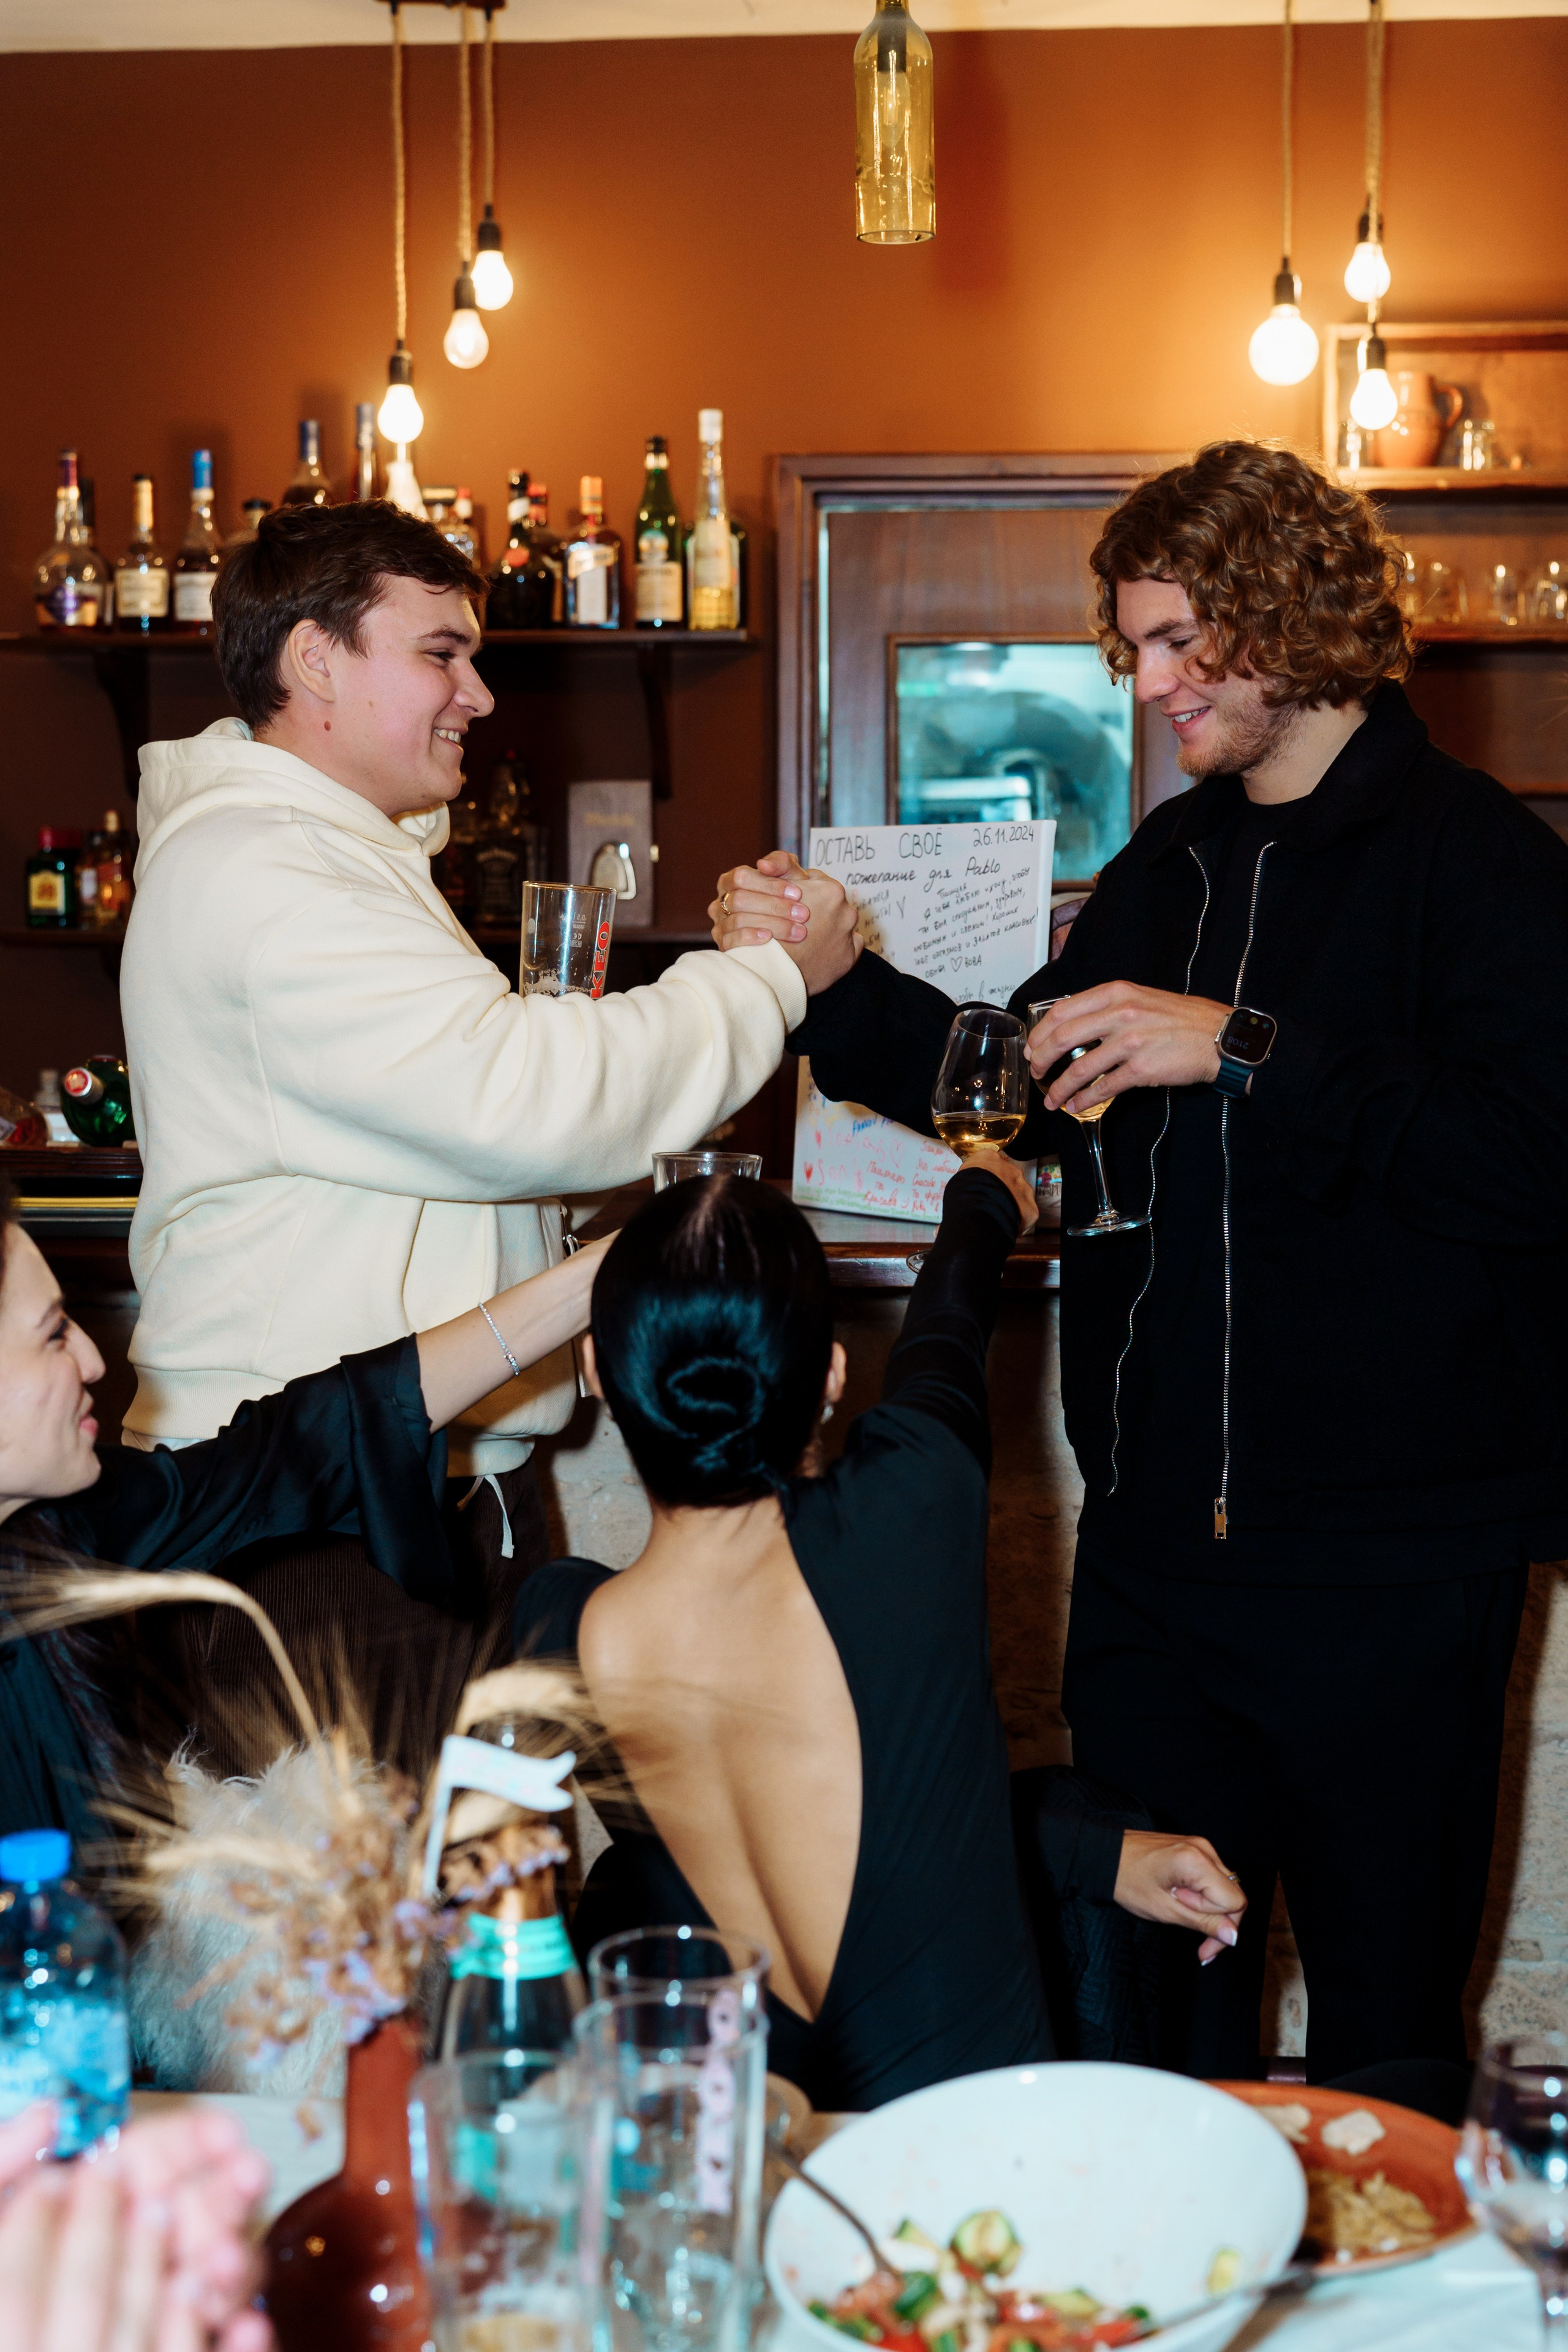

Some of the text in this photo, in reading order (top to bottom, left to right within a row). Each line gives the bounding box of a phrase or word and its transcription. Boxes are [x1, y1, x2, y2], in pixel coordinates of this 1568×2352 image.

[815, 827, 943, 866] ОСТАВЬ СВОЁ
[973, 825, 1035, 847] 26.11.2024
[845, 856, 1001, 893] пожелание для Pablo
[590, 921, 610, 999] KEO
[965, 954, 982, 968] ВОВА
[1228, 1036, 1248, 1049] 21:08
